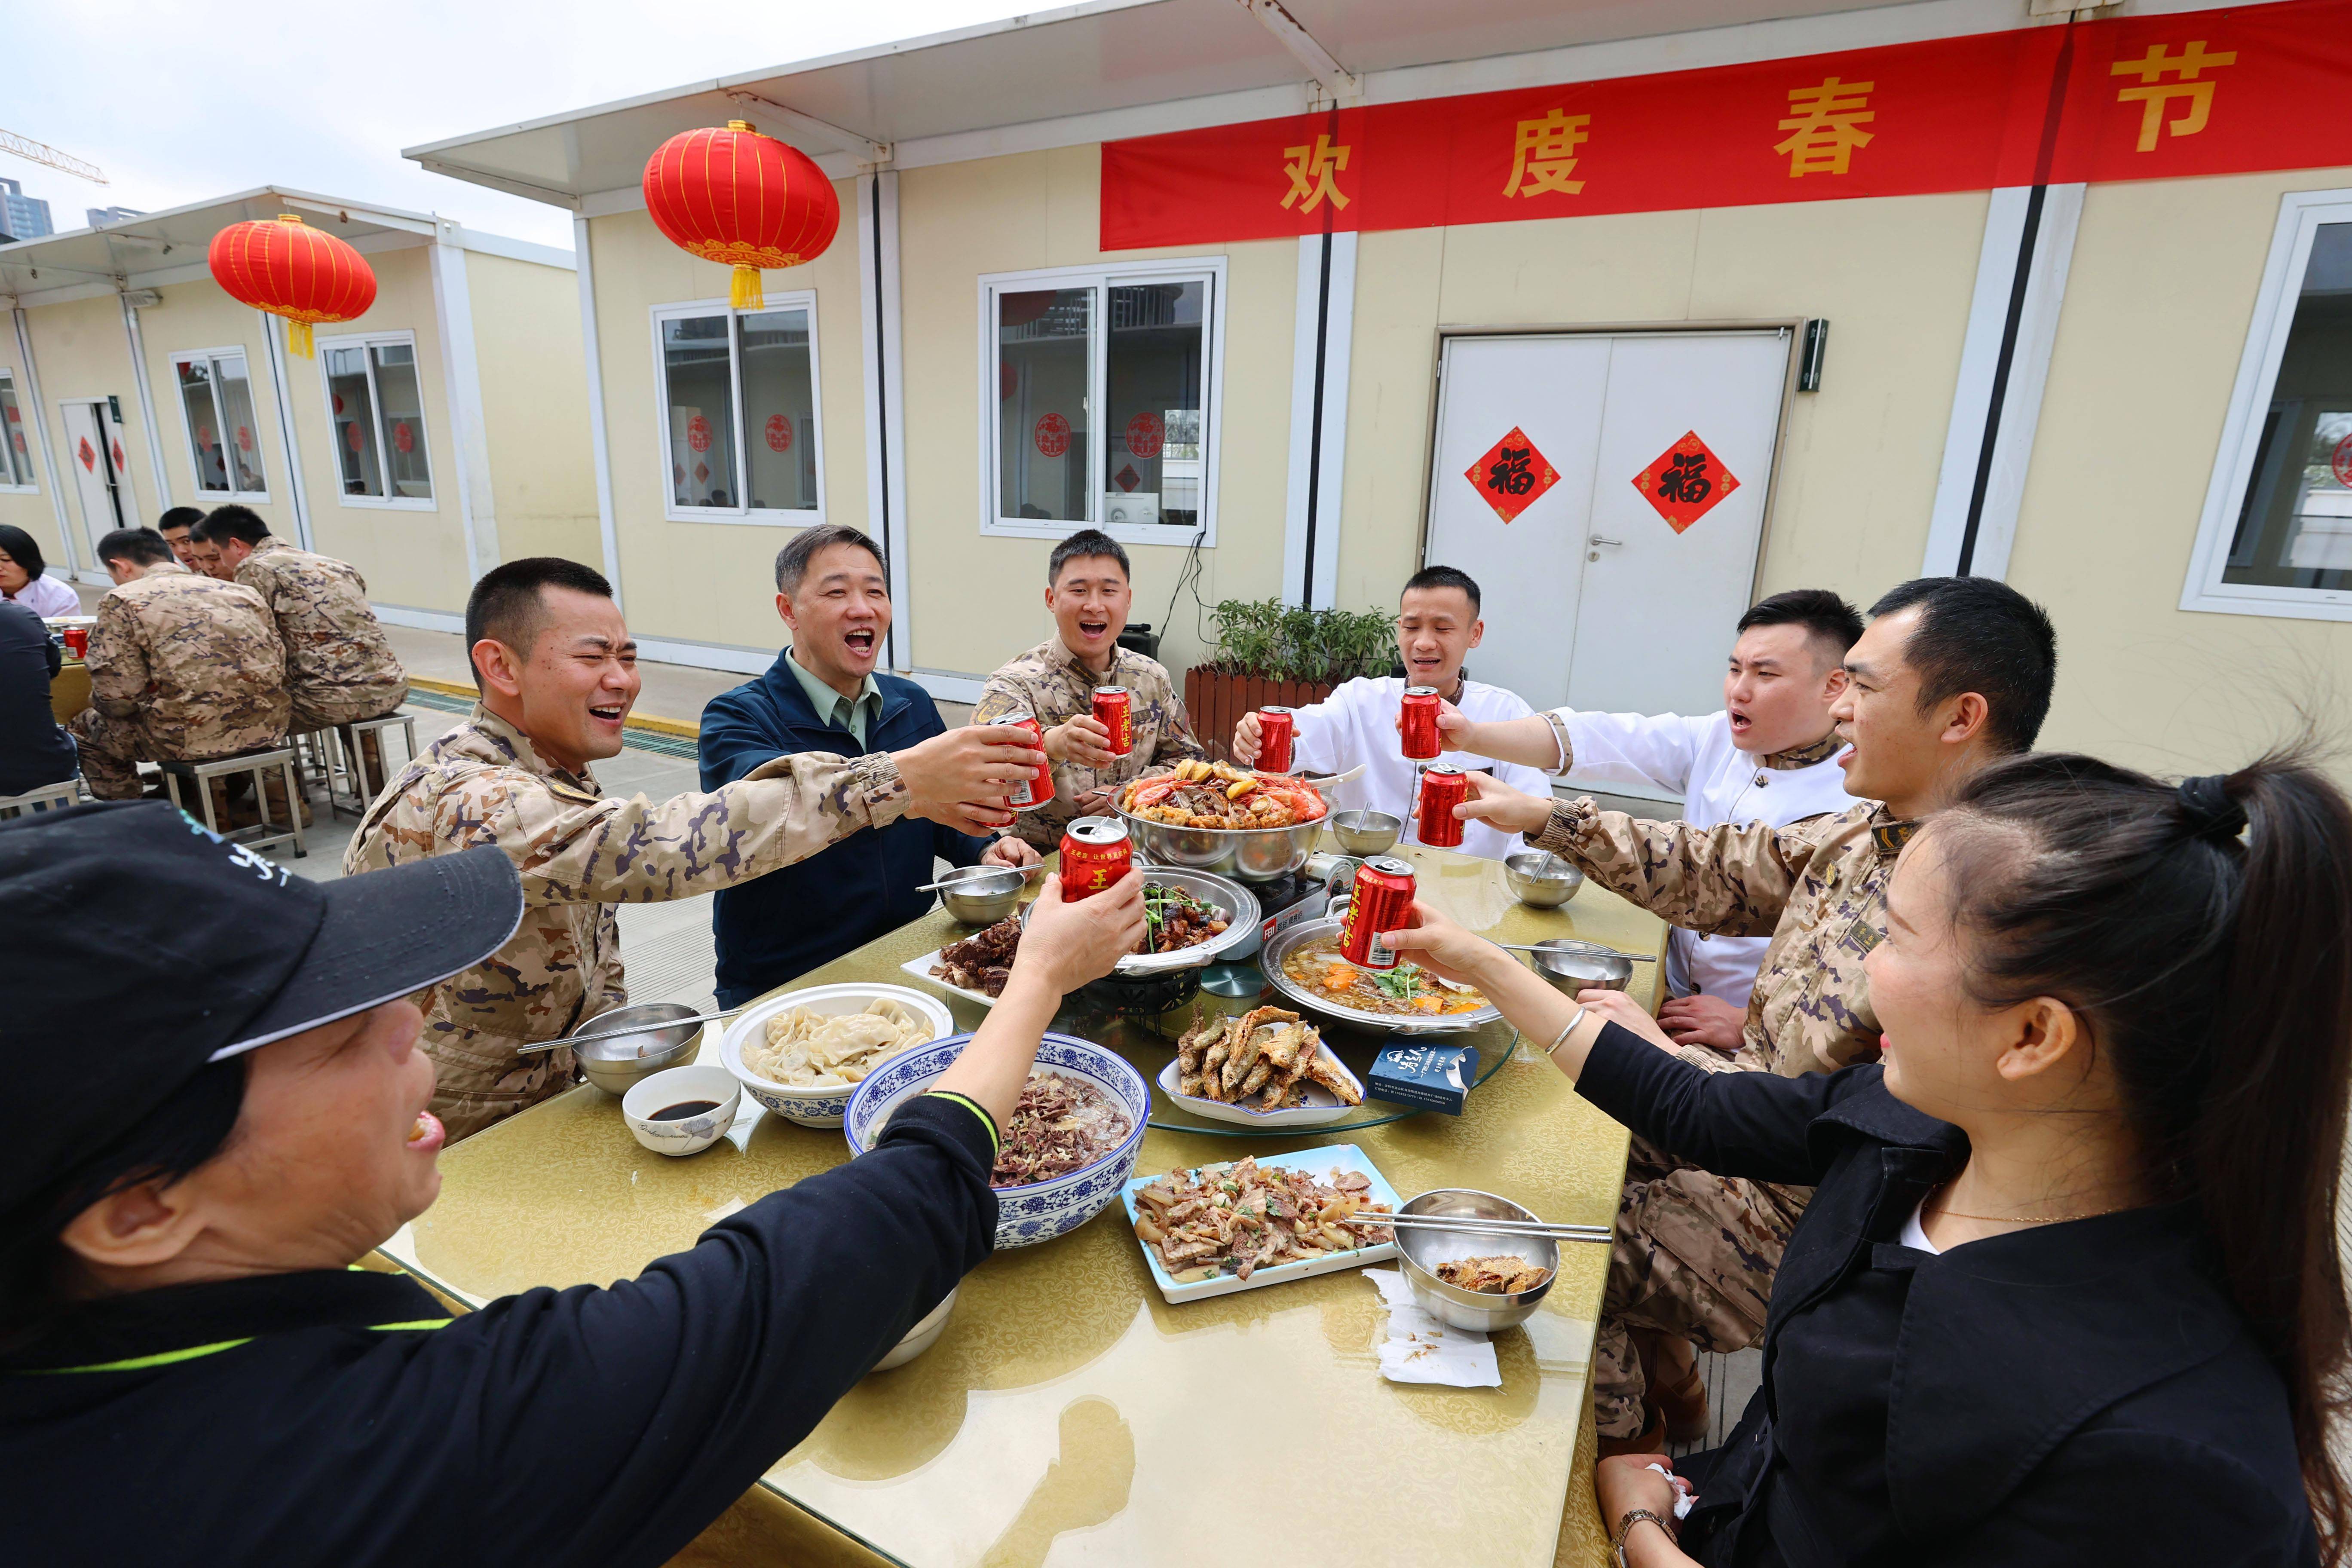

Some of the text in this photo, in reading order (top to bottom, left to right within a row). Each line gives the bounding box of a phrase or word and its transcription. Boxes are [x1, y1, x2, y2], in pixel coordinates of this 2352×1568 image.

[1280, 40, 2238, 215] 欢度春节
[1488, 448, 1536, 495] 福
[1658, 453, 1712, 503] 福
[1121, 704, 1130, 747] 王老吉
[1070, 848, 1127, 860] 王老吉 让世界更吉祥
[1343, 883, 1362, 948] 王老吉
